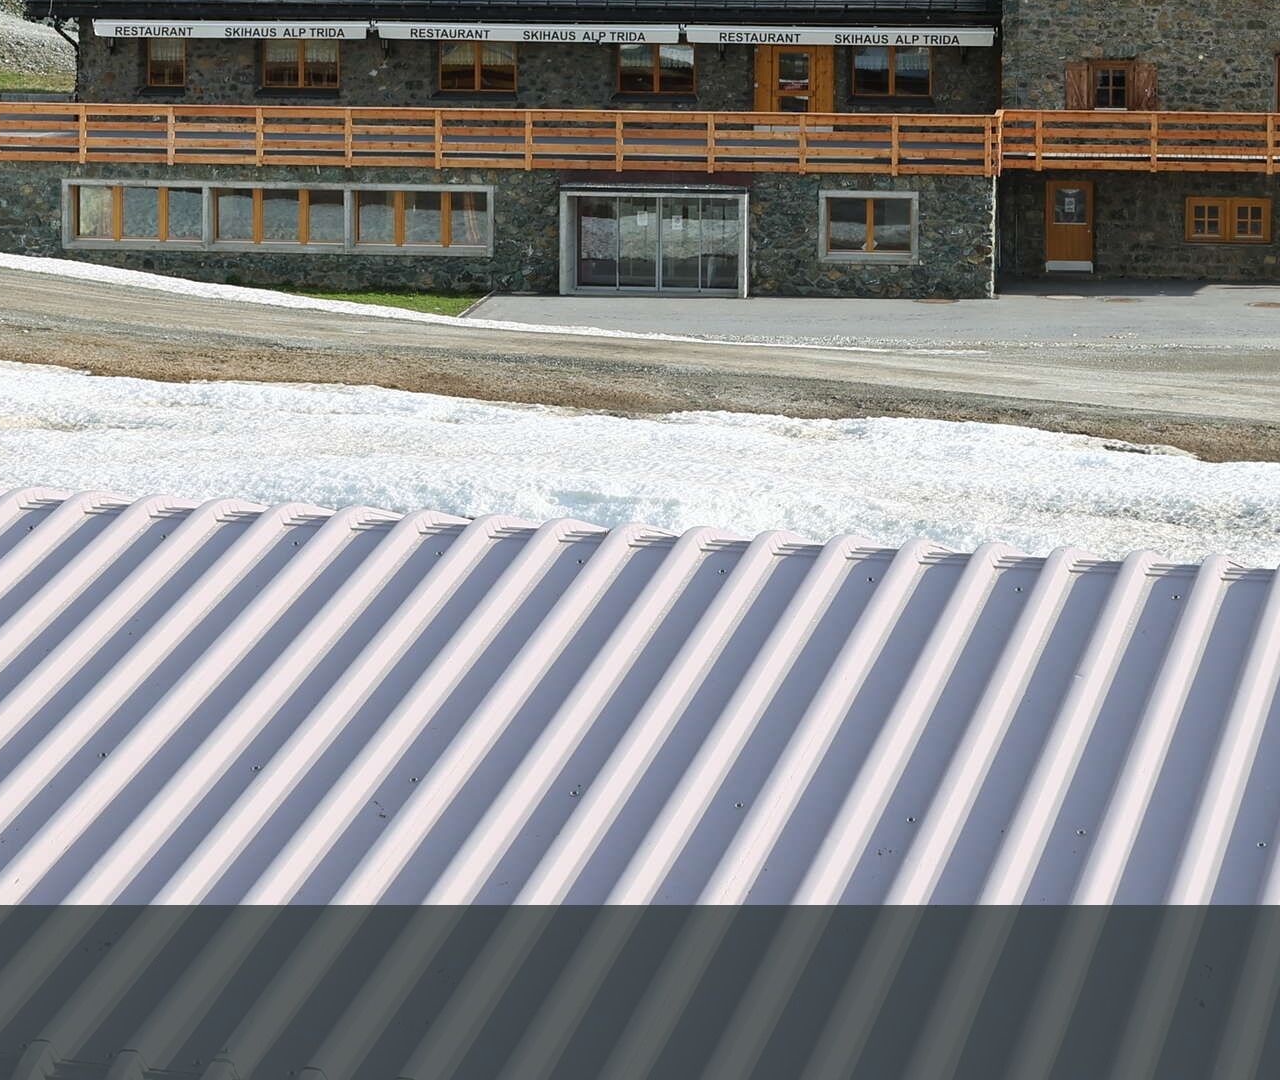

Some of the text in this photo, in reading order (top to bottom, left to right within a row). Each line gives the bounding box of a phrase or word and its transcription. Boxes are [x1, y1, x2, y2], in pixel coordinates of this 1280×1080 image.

[114, 26, 346, 38] RESTAURANT SKIHAUS ALP TRIDA
[410, 28, 646, 42] RESTAURANT SKIHAUS ALP TRIDA
[719, 32, 960, 45] RESTAURANT SKIHAUS ALP TRIDA
